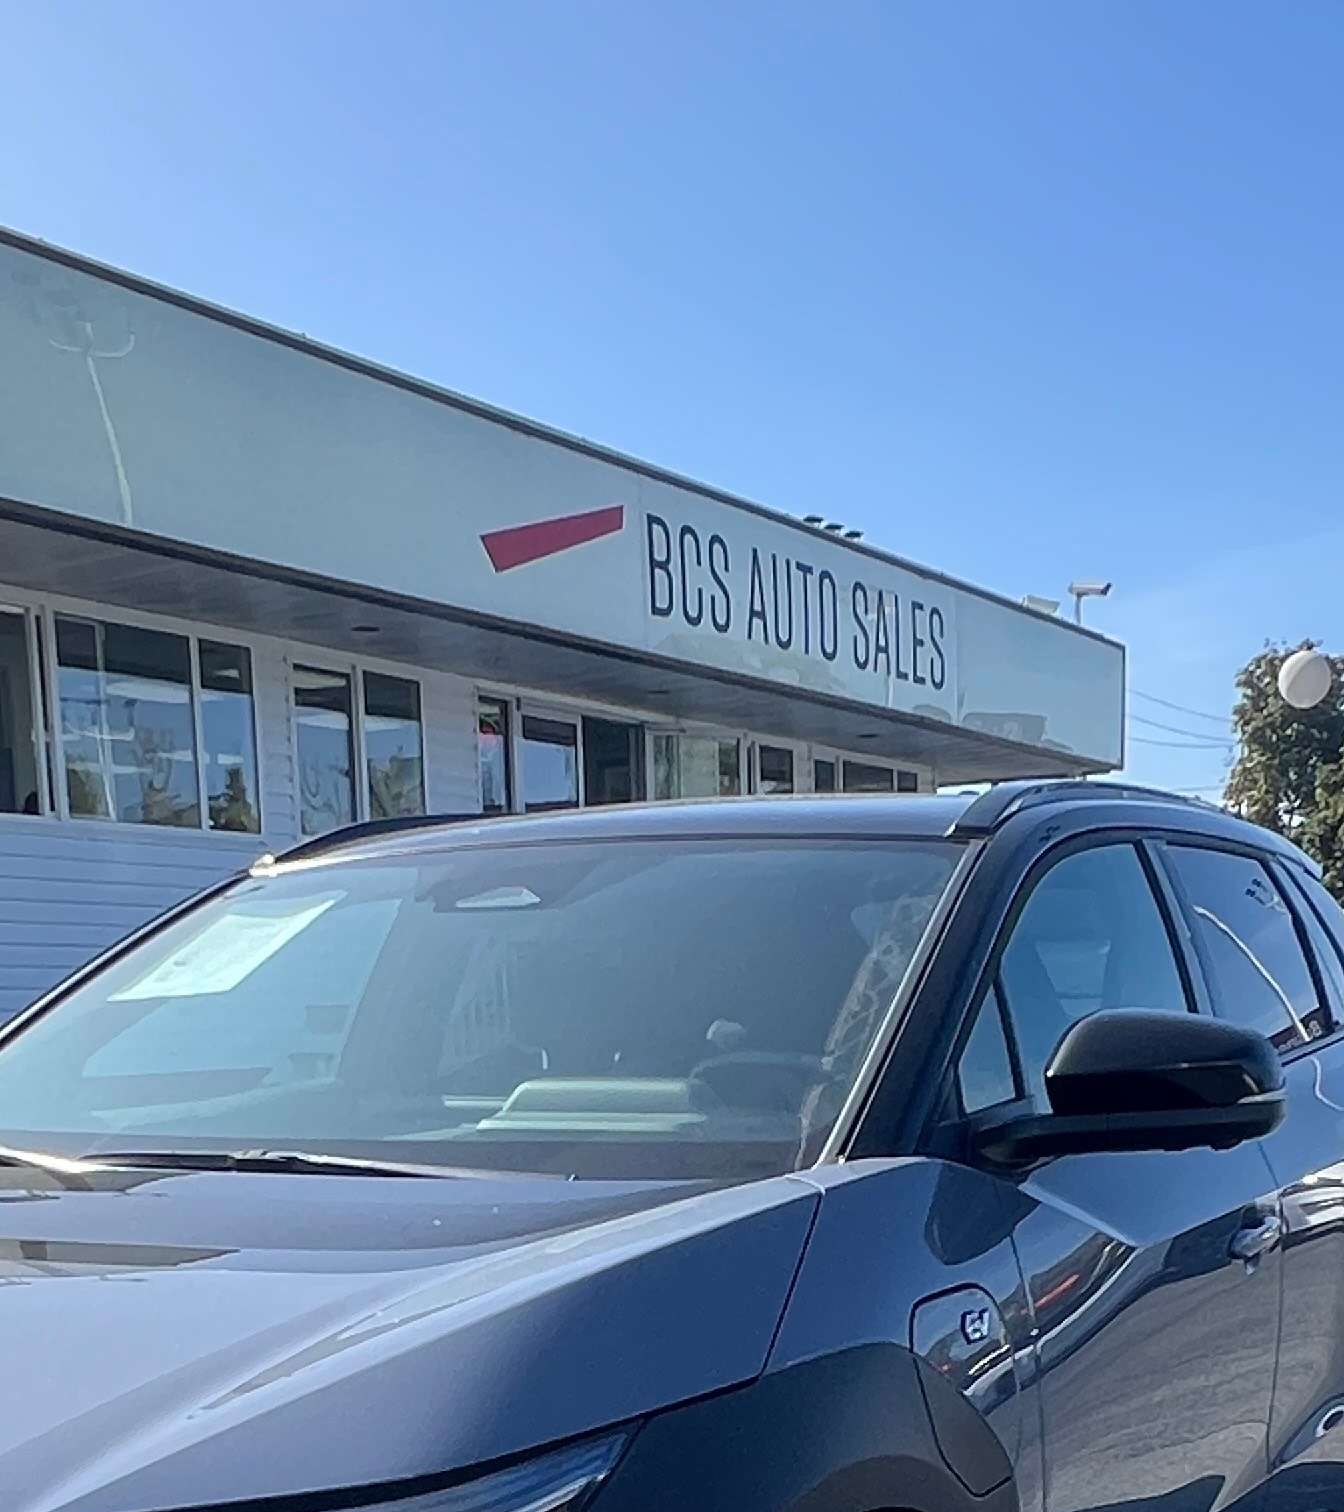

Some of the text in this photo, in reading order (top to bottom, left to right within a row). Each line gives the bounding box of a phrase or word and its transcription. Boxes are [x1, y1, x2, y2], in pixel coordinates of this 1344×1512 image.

[646, 513, 946, 690] BCS AUTO SALES
